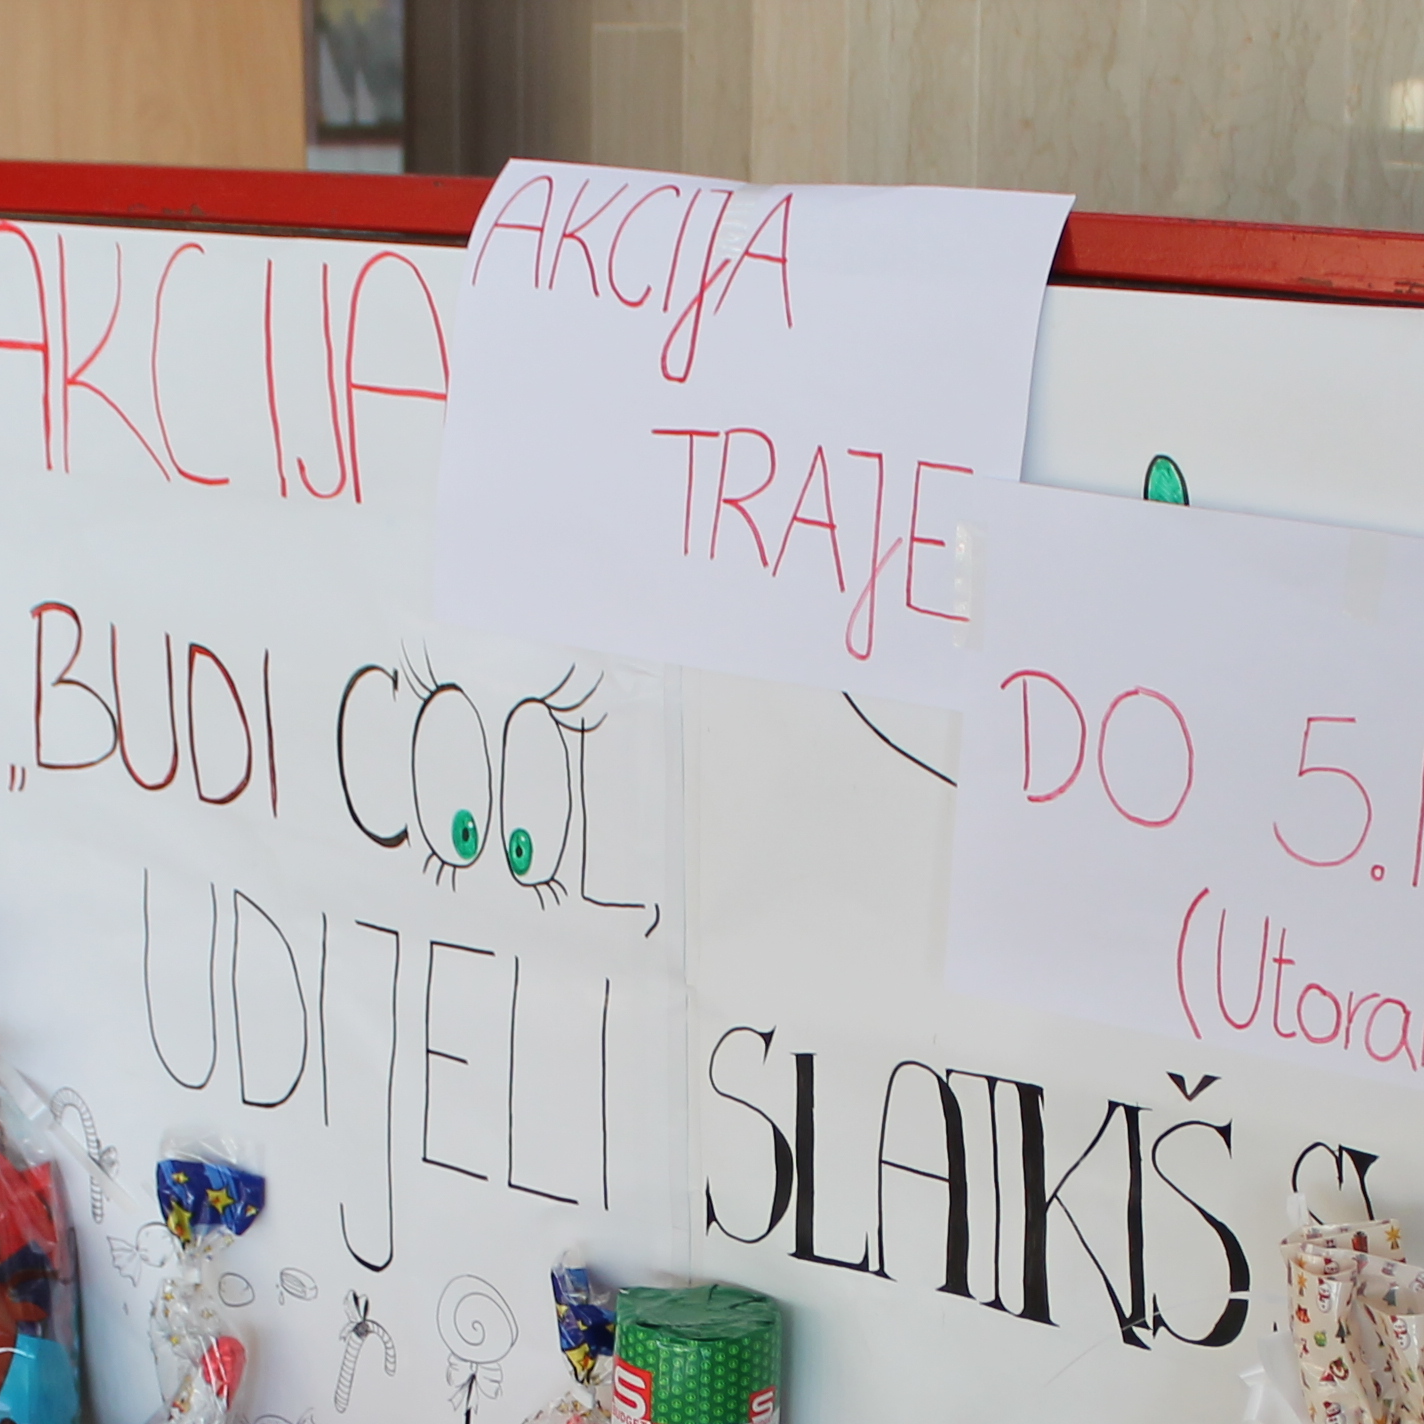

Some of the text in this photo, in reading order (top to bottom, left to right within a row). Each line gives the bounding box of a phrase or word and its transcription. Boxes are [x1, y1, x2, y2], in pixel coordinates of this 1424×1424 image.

[473, 174, 794, 384] AKCIJA
[651, 428, 974, 661] TRAJE
[999, 670, 1196, 828] DO
[143, 868, 610, 1272] UDIJELI
